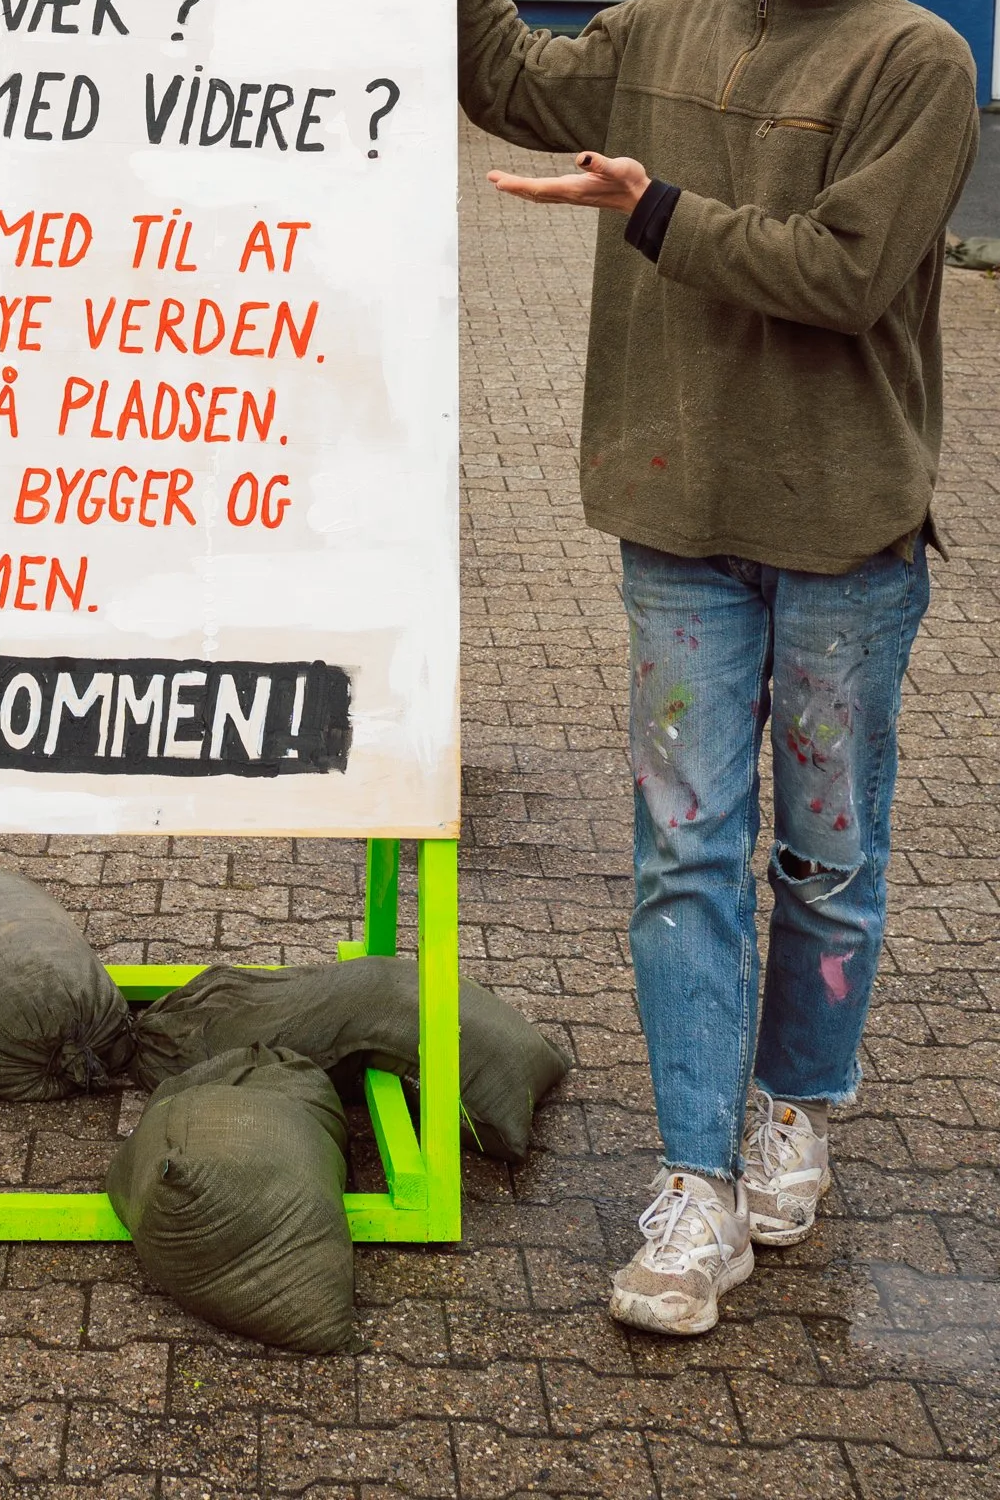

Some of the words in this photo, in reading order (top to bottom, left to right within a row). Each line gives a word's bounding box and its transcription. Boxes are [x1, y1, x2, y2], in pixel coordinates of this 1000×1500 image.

[239, 221, 311, 272] AT
[85, 297, 325, 362] VERDEN.
[58, 376, 287, 445] PLADSEN.
[14, 466, 196, 527] BYGGER
[227, 472, 291, 529] OG
